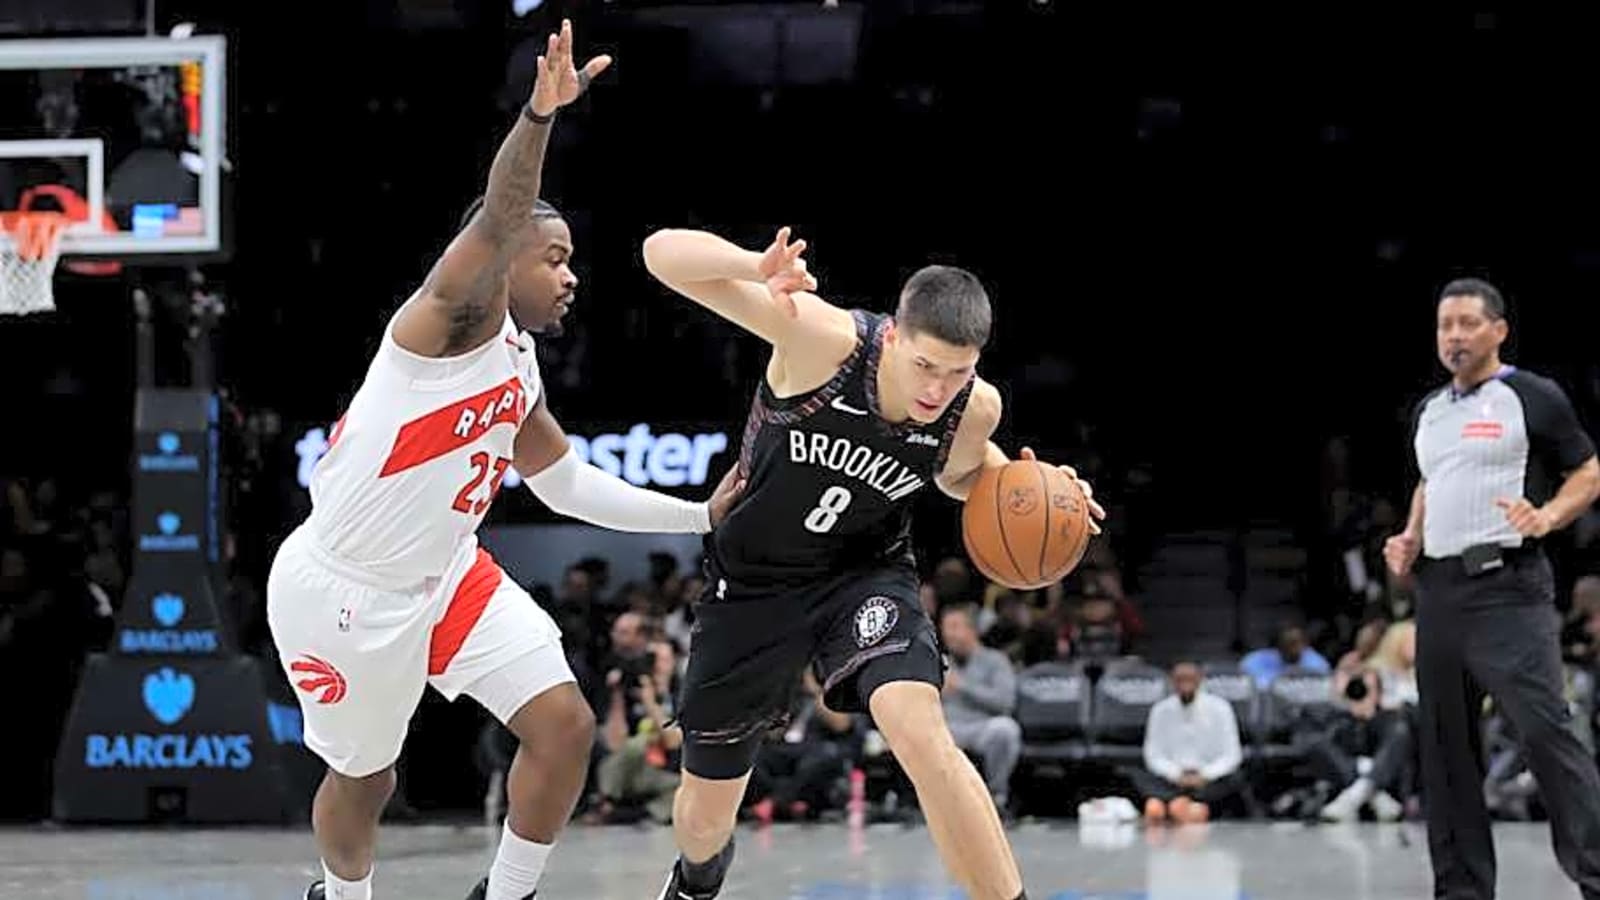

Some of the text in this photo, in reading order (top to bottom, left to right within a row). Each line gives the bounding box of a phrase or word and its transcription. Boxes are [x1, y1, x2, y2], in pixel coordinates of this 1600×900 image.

[803, 485, 852, 533] 8
[119, 629, 218, 652] BARCLAYS
[85, 733, 253, 769] BARCLAYS
